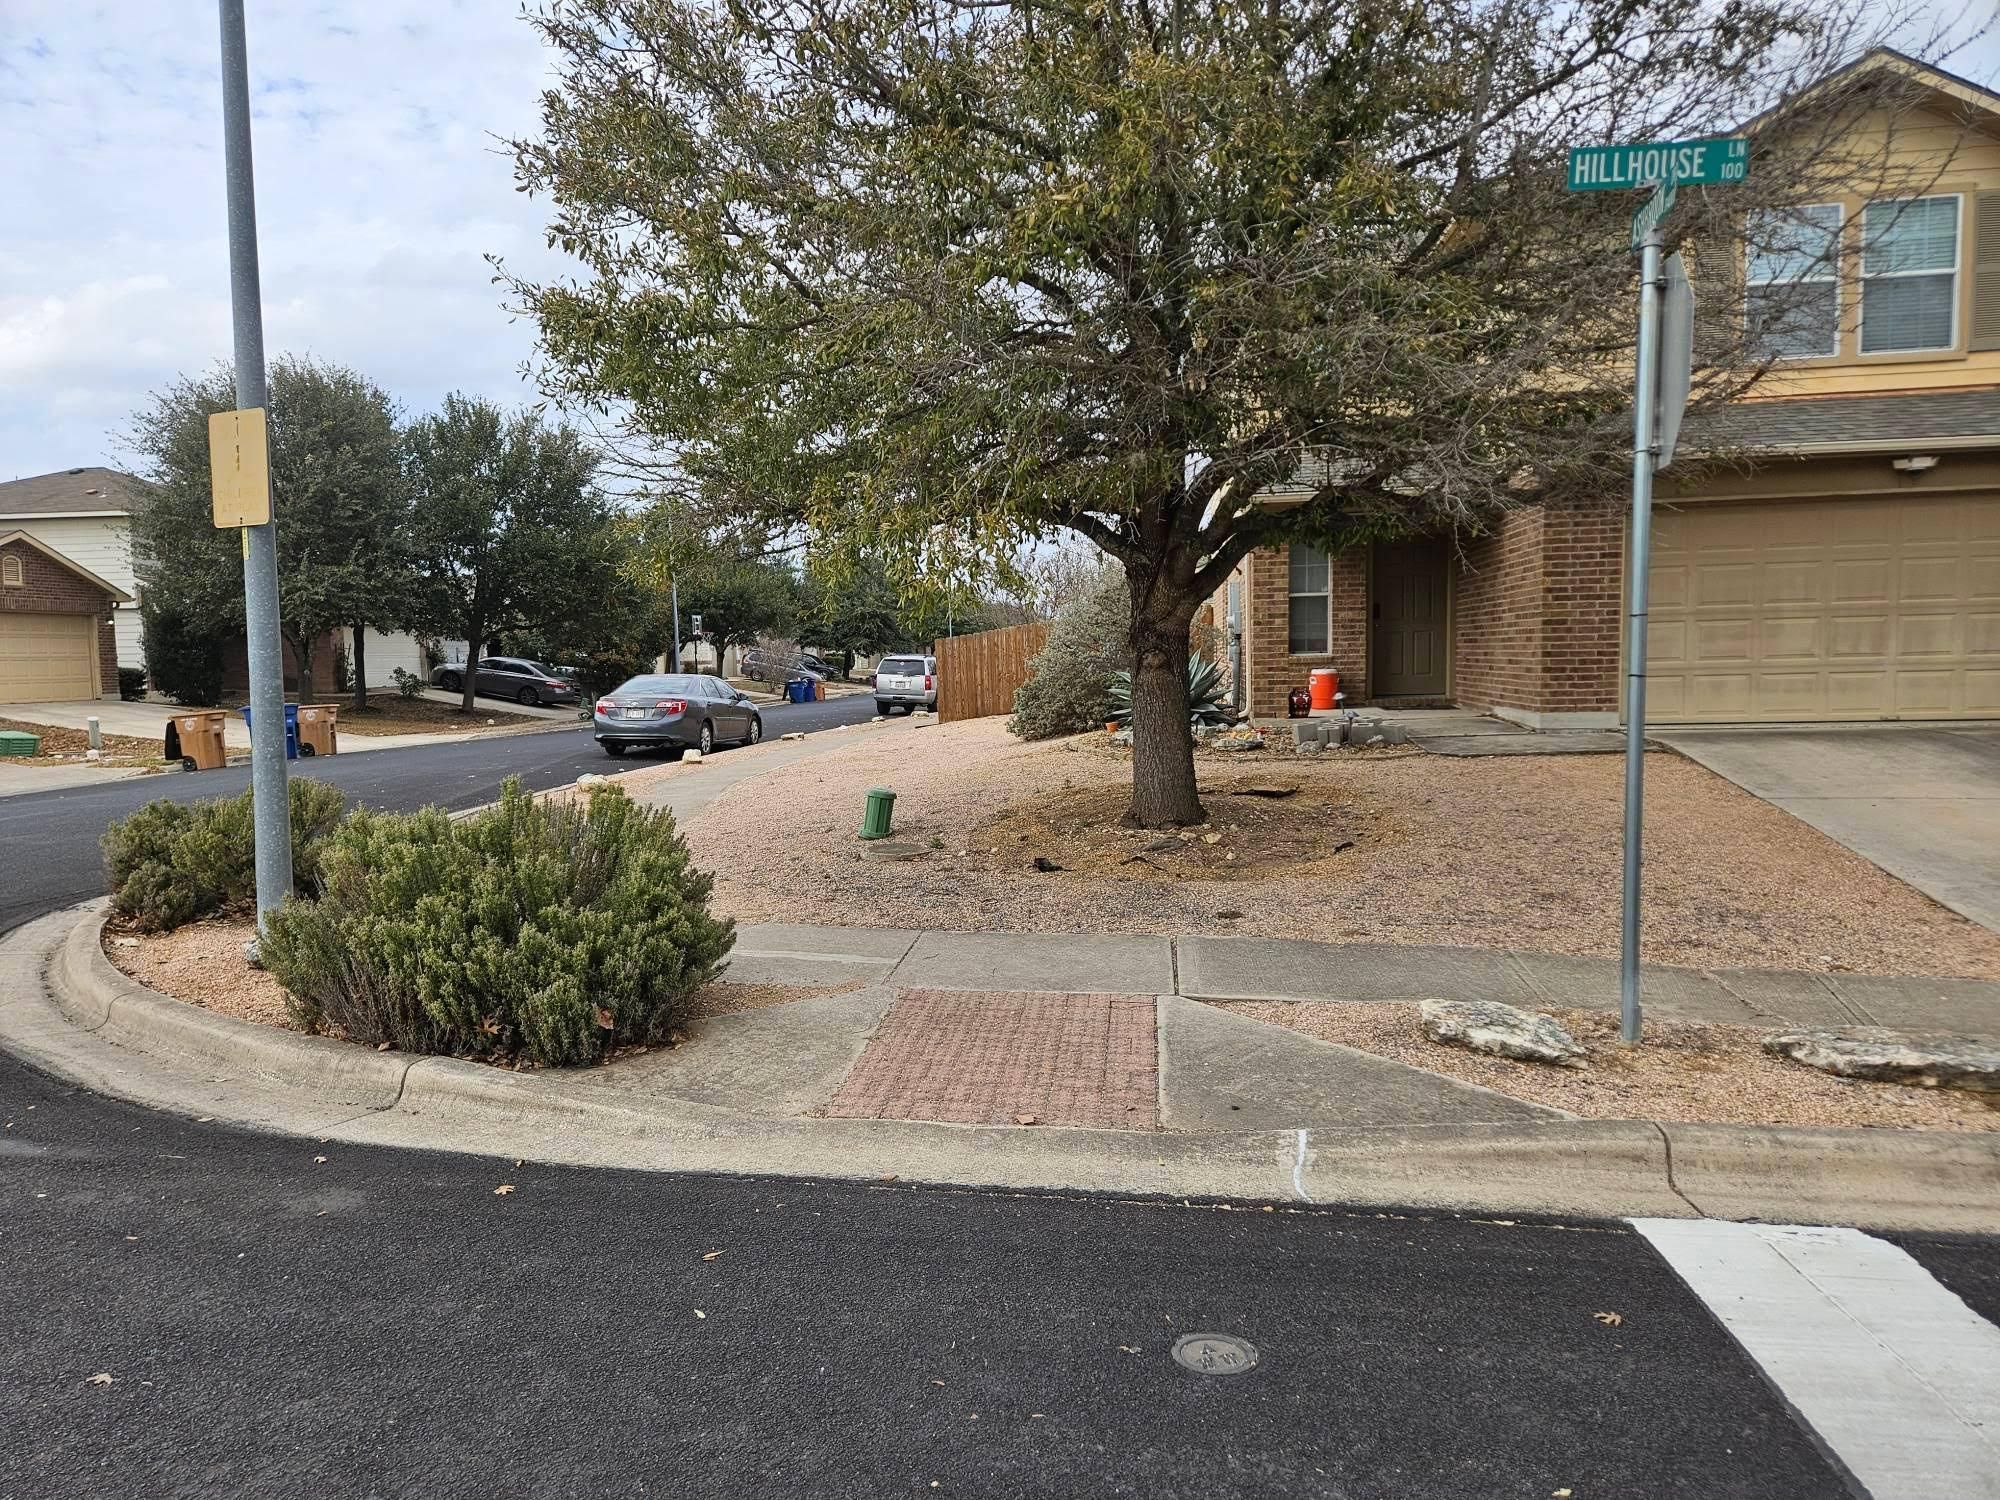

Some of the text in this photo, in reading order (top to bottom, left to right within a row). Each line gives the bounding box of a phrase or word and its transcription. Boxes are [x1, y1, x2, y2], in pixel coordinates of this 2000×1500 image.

[1575, 141, 1746, 184] HILLHOUSE LN
[1720, 162, 1744, 180] 100
